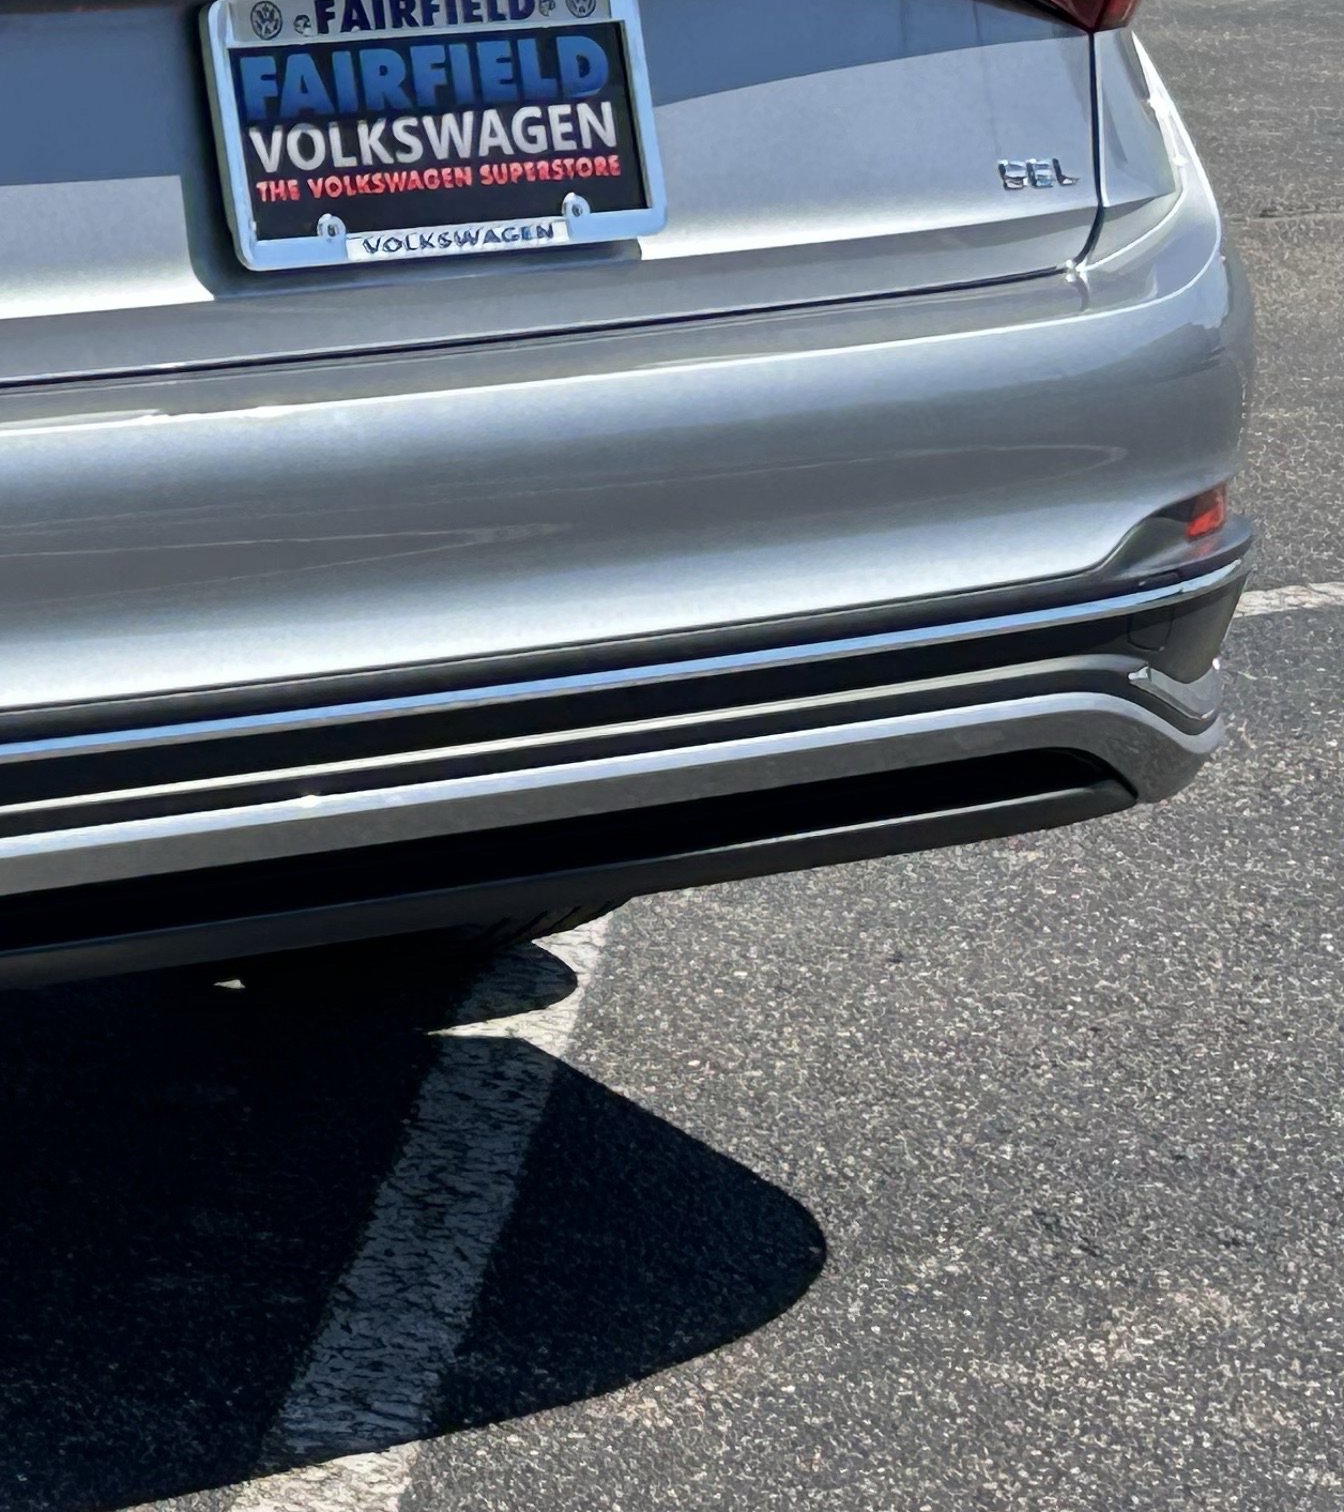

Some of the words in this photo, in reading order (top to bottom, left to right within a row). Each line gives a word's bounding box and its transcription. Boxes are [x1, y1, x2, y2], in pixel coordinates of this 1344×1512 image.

[239, 34, 610, 121] FAIRFIELD
[248, 100, 618, 174] VOLKSWAGEN
[256, 175, 301, 203] THE
[307, 168, 473, 200] VOLKSWAGEN
[480, 153, 621, 186] SUPERSTORE
[362, 222, 555, 255] VOLKSWAGEN
